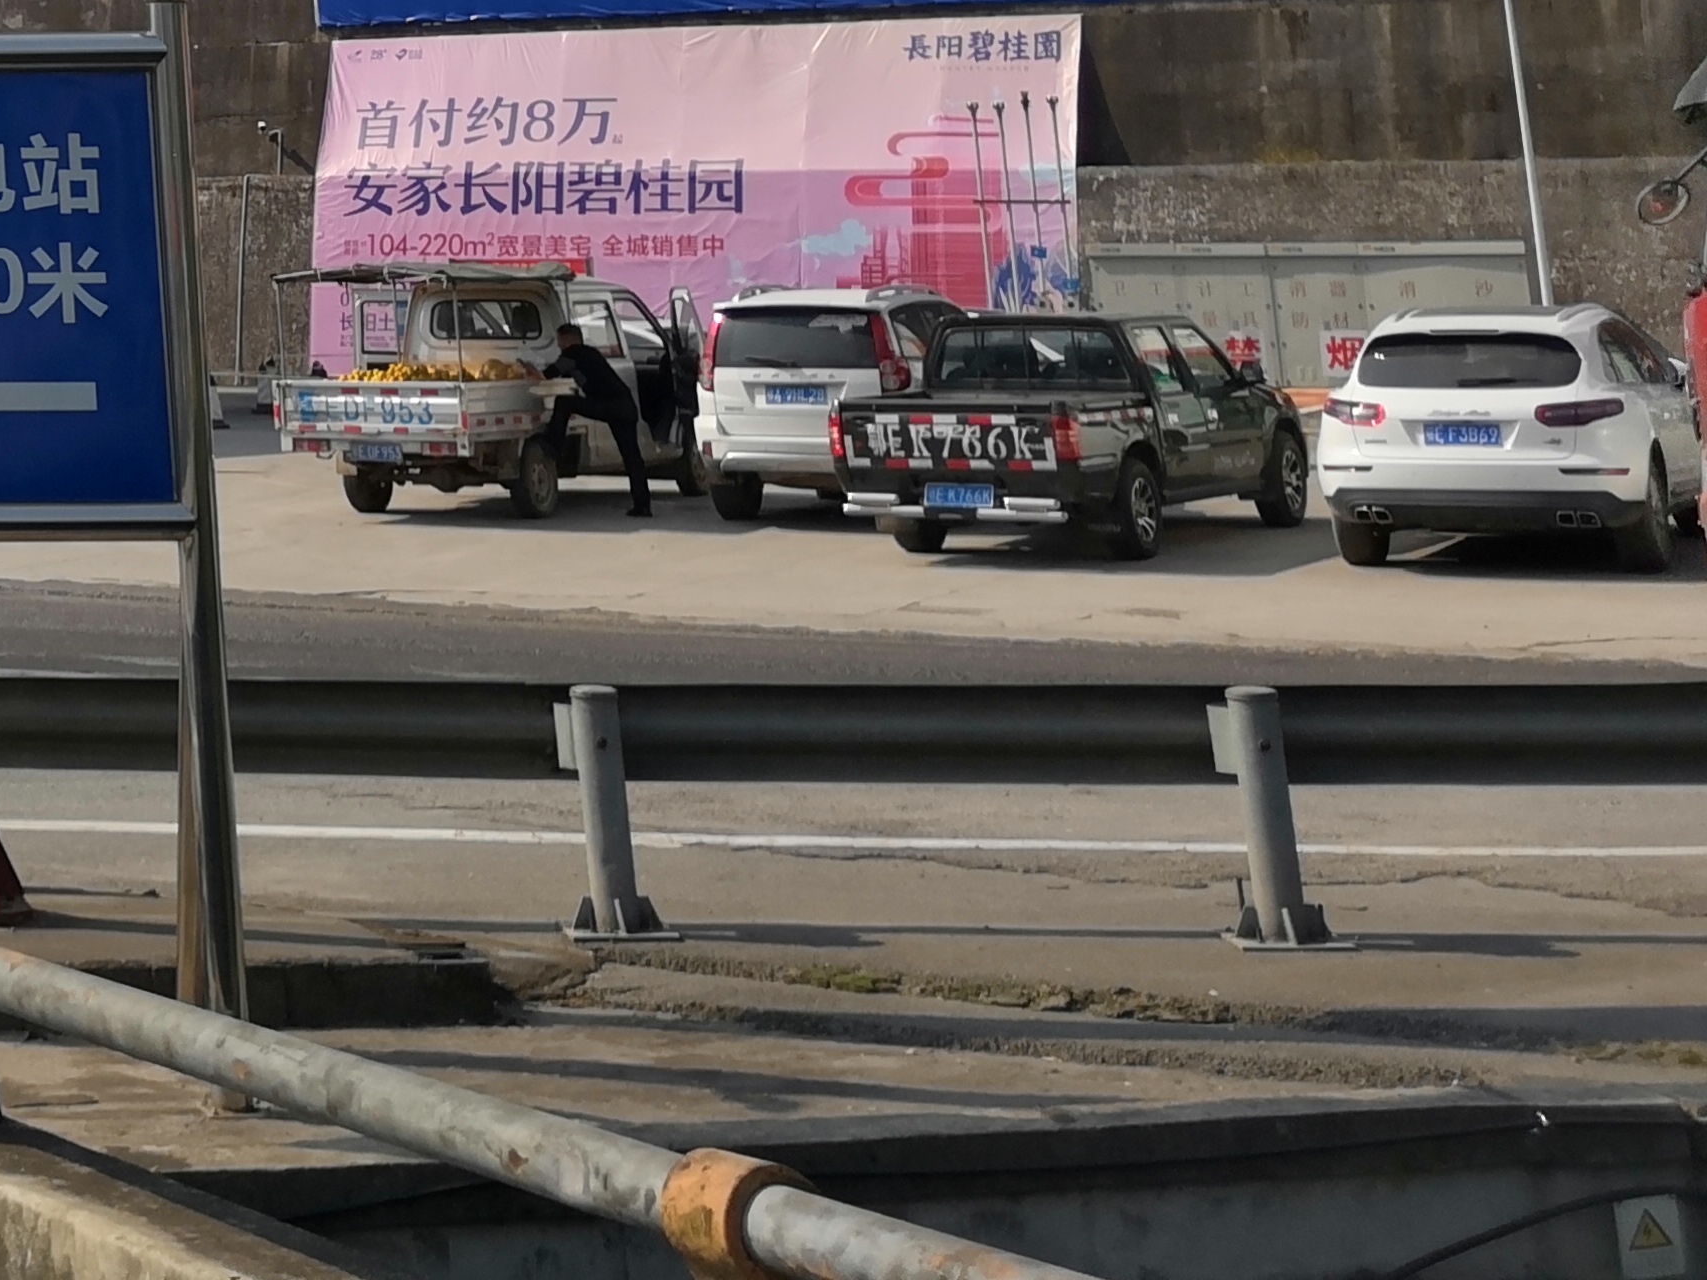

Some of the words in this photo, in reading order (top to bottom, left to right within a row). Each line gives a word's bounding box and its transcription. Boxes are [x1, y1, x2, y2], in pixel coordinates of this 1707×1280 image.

[356, 95, 618, 150] 首付约8万
[343, 158, 744, 217] 安家长阳碧桂园
[602, 233, 726, 258] 全城销售中
